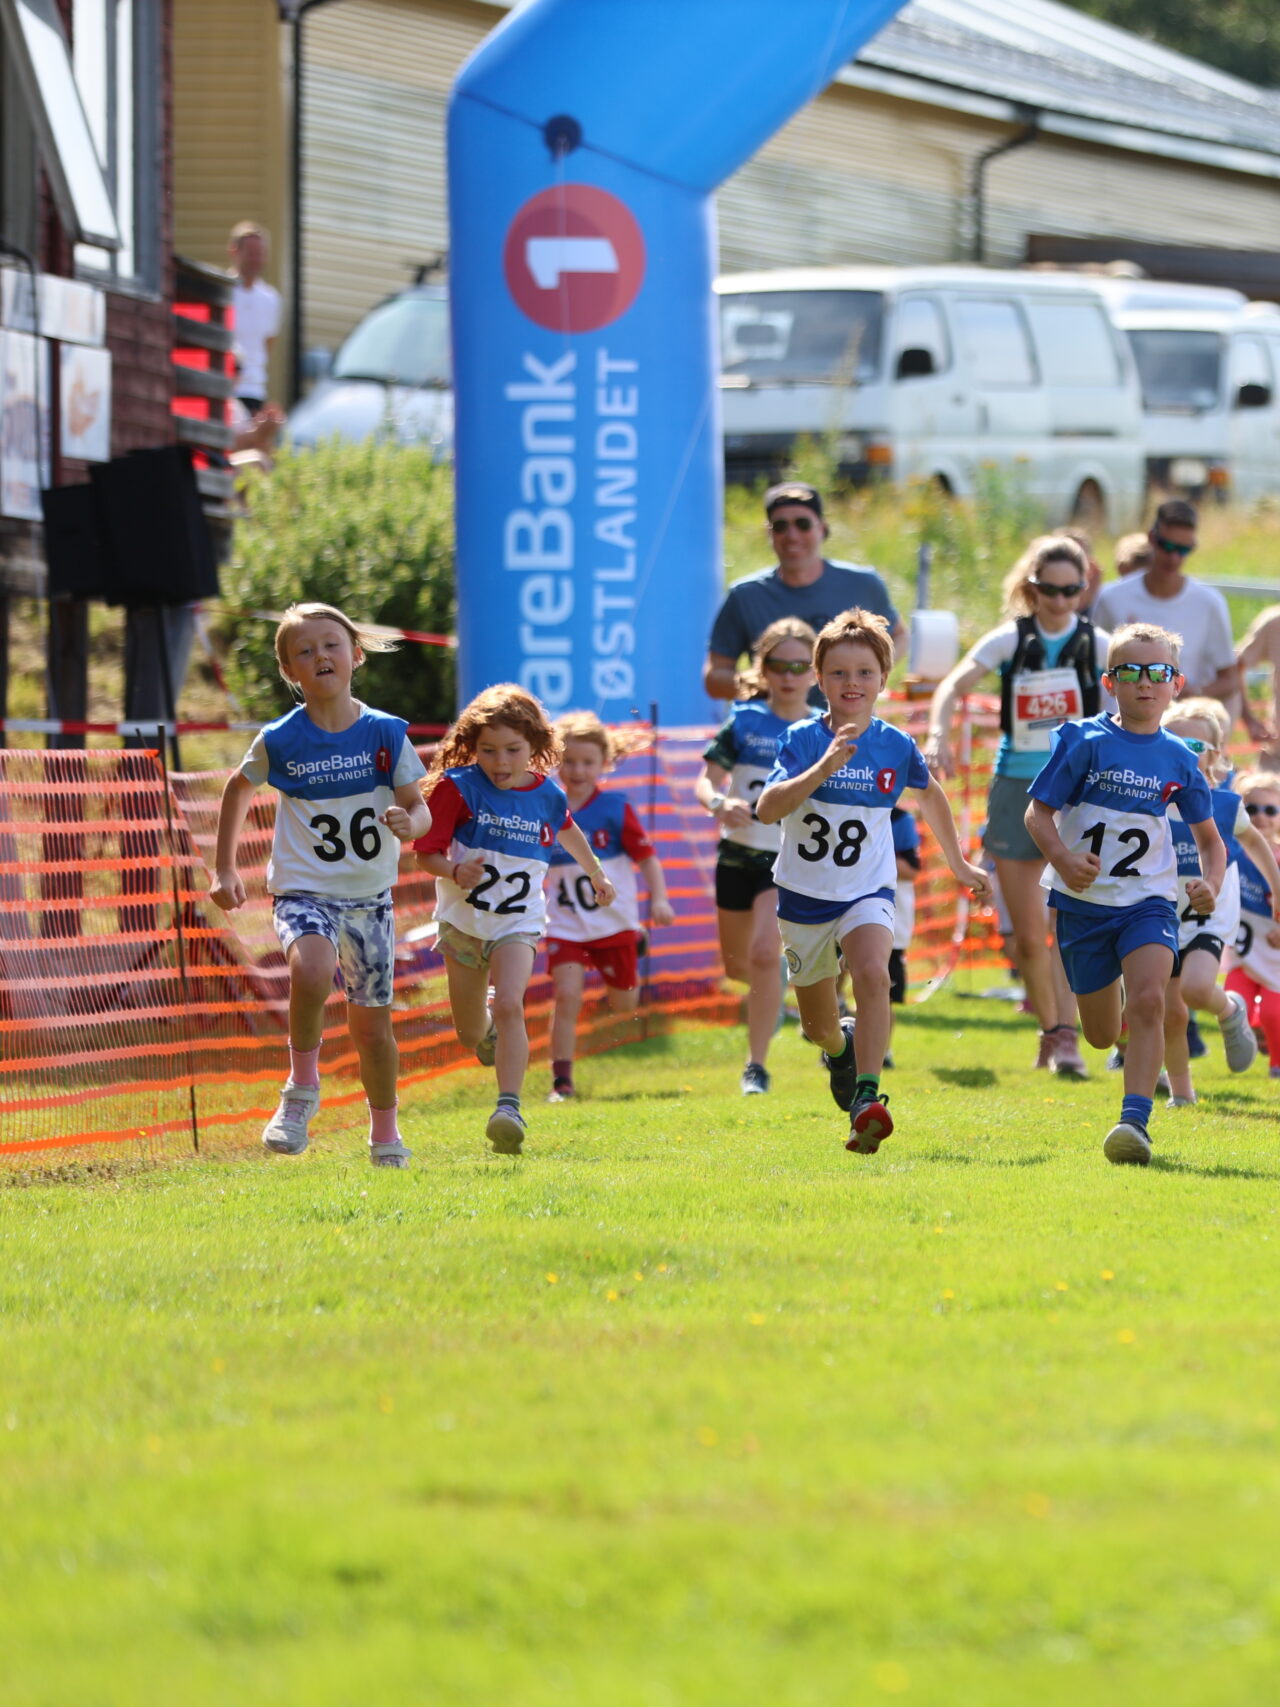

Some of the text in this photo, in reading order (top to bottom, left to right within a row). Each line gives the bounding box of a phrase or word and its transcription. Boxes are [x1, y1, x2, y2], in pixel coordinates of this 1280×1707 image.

[504, 236, 620, 706] areBank 1
[593, 348, 638, 700] ØSTLANDET
[1025, 692, 1069, 717] 426
[286, 751, 373, 777] SpareBank
[308, 767, 374, 785] ØSTLANDET
[831, 766, 874, 781] eBank
[1086, 768, 1162, 791] SpareBank
[822, 780, 875, 792] STLANDET
[309, 807, 382, 862] 36
[797, 812, 868, 868] 38
[1081, 821, 1150, 877] 12
[465, 864, 531, 915] 22
